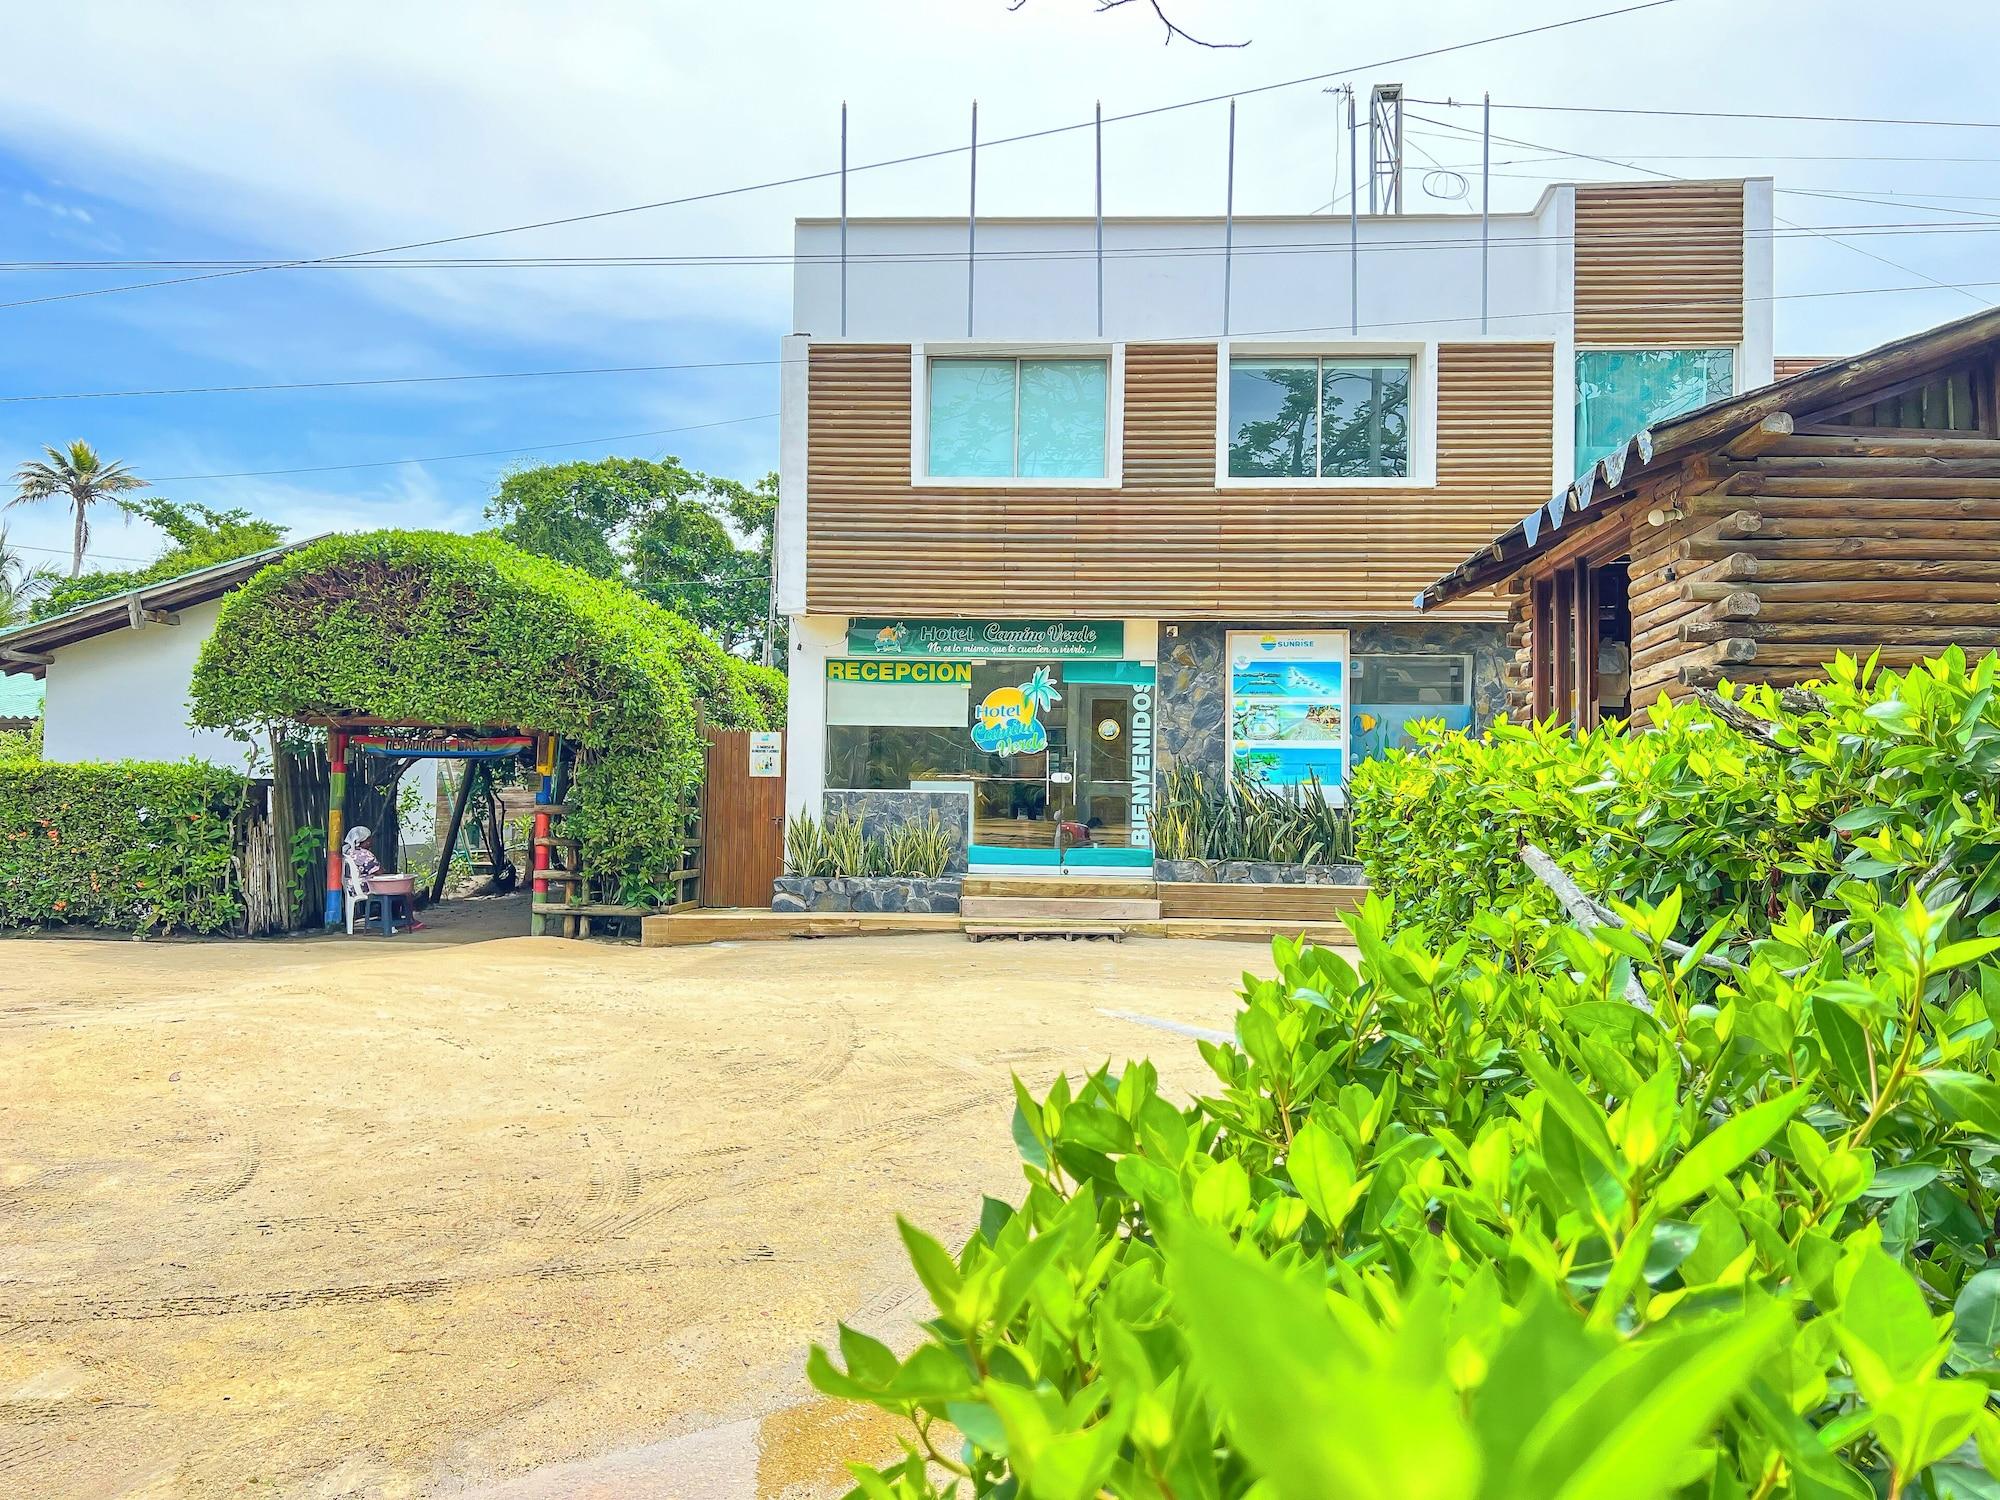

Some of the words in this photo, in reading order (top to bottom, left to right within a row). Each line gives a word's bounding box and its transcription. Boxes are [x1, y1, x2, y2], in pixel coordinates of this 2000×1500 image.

[920, 625, 975, 642] Hotel
[982, 622, 1046, 643] Camino
[1046, 622, 1097, 643] Verde
[927, 641, 942, 653] No
[952, 643, 961, 653] lo
[962, 643, 989, 653] mismo
[991, 646, 1006, 655] que
[1007, 643, 1016, 653] te
[1277, 640, 1314, 648] SUNRISE
[975, 704, 1021, 718] Hotel
[996, 732, 1048, 757] Verde
